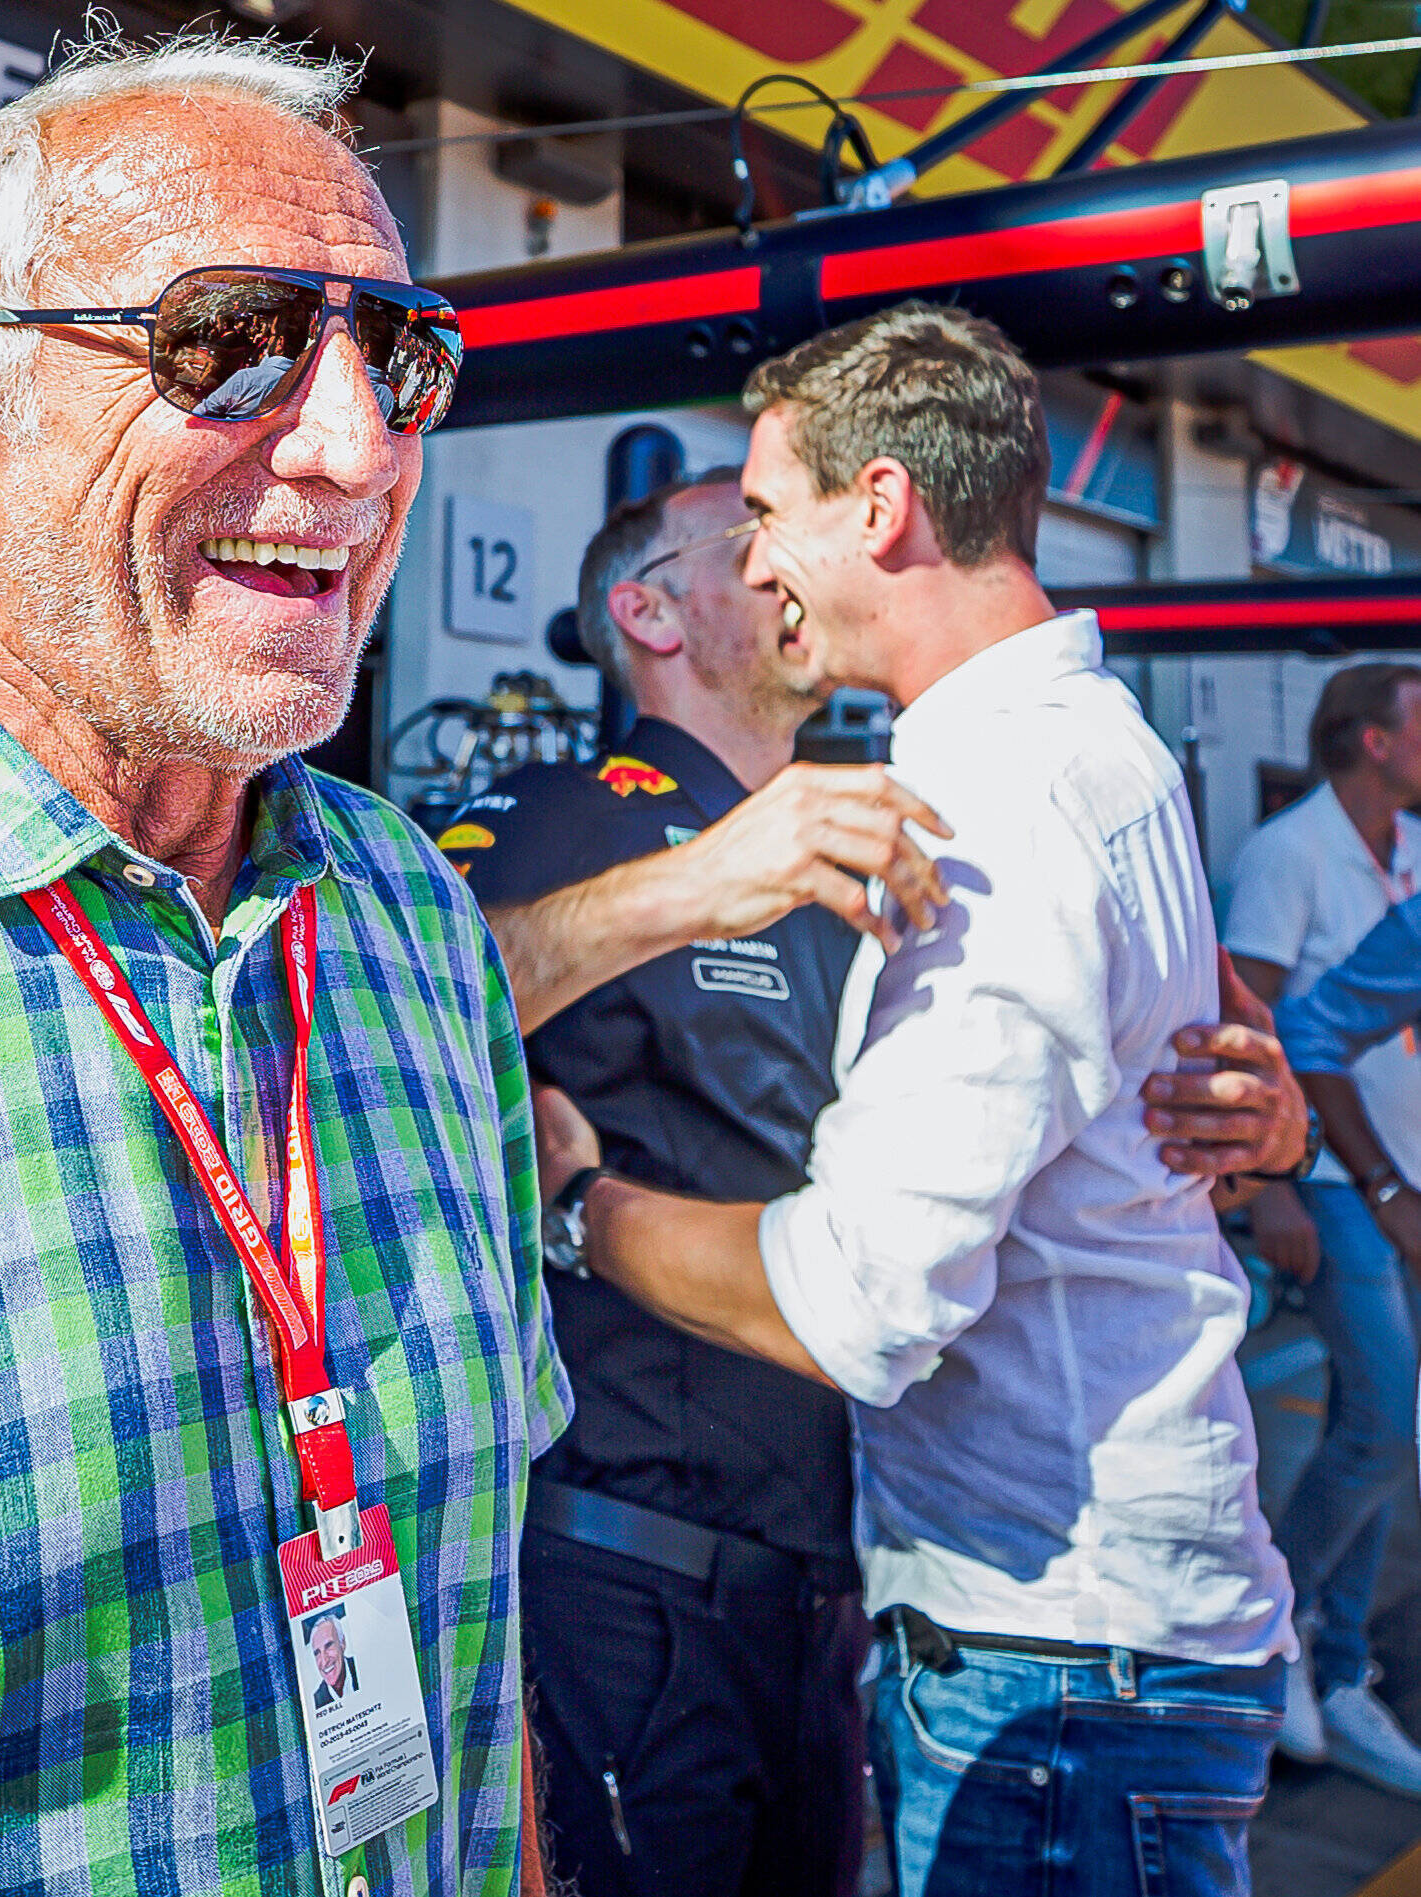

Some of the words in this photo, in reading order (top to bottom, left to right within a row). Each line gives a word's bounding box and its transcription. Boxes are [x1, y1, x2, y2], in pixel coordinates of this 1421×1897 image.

[470, 537, 517, 602] 12
[215, 1174, 260, 1248] GRID
[302, 1576, 344, 1606] PIT
